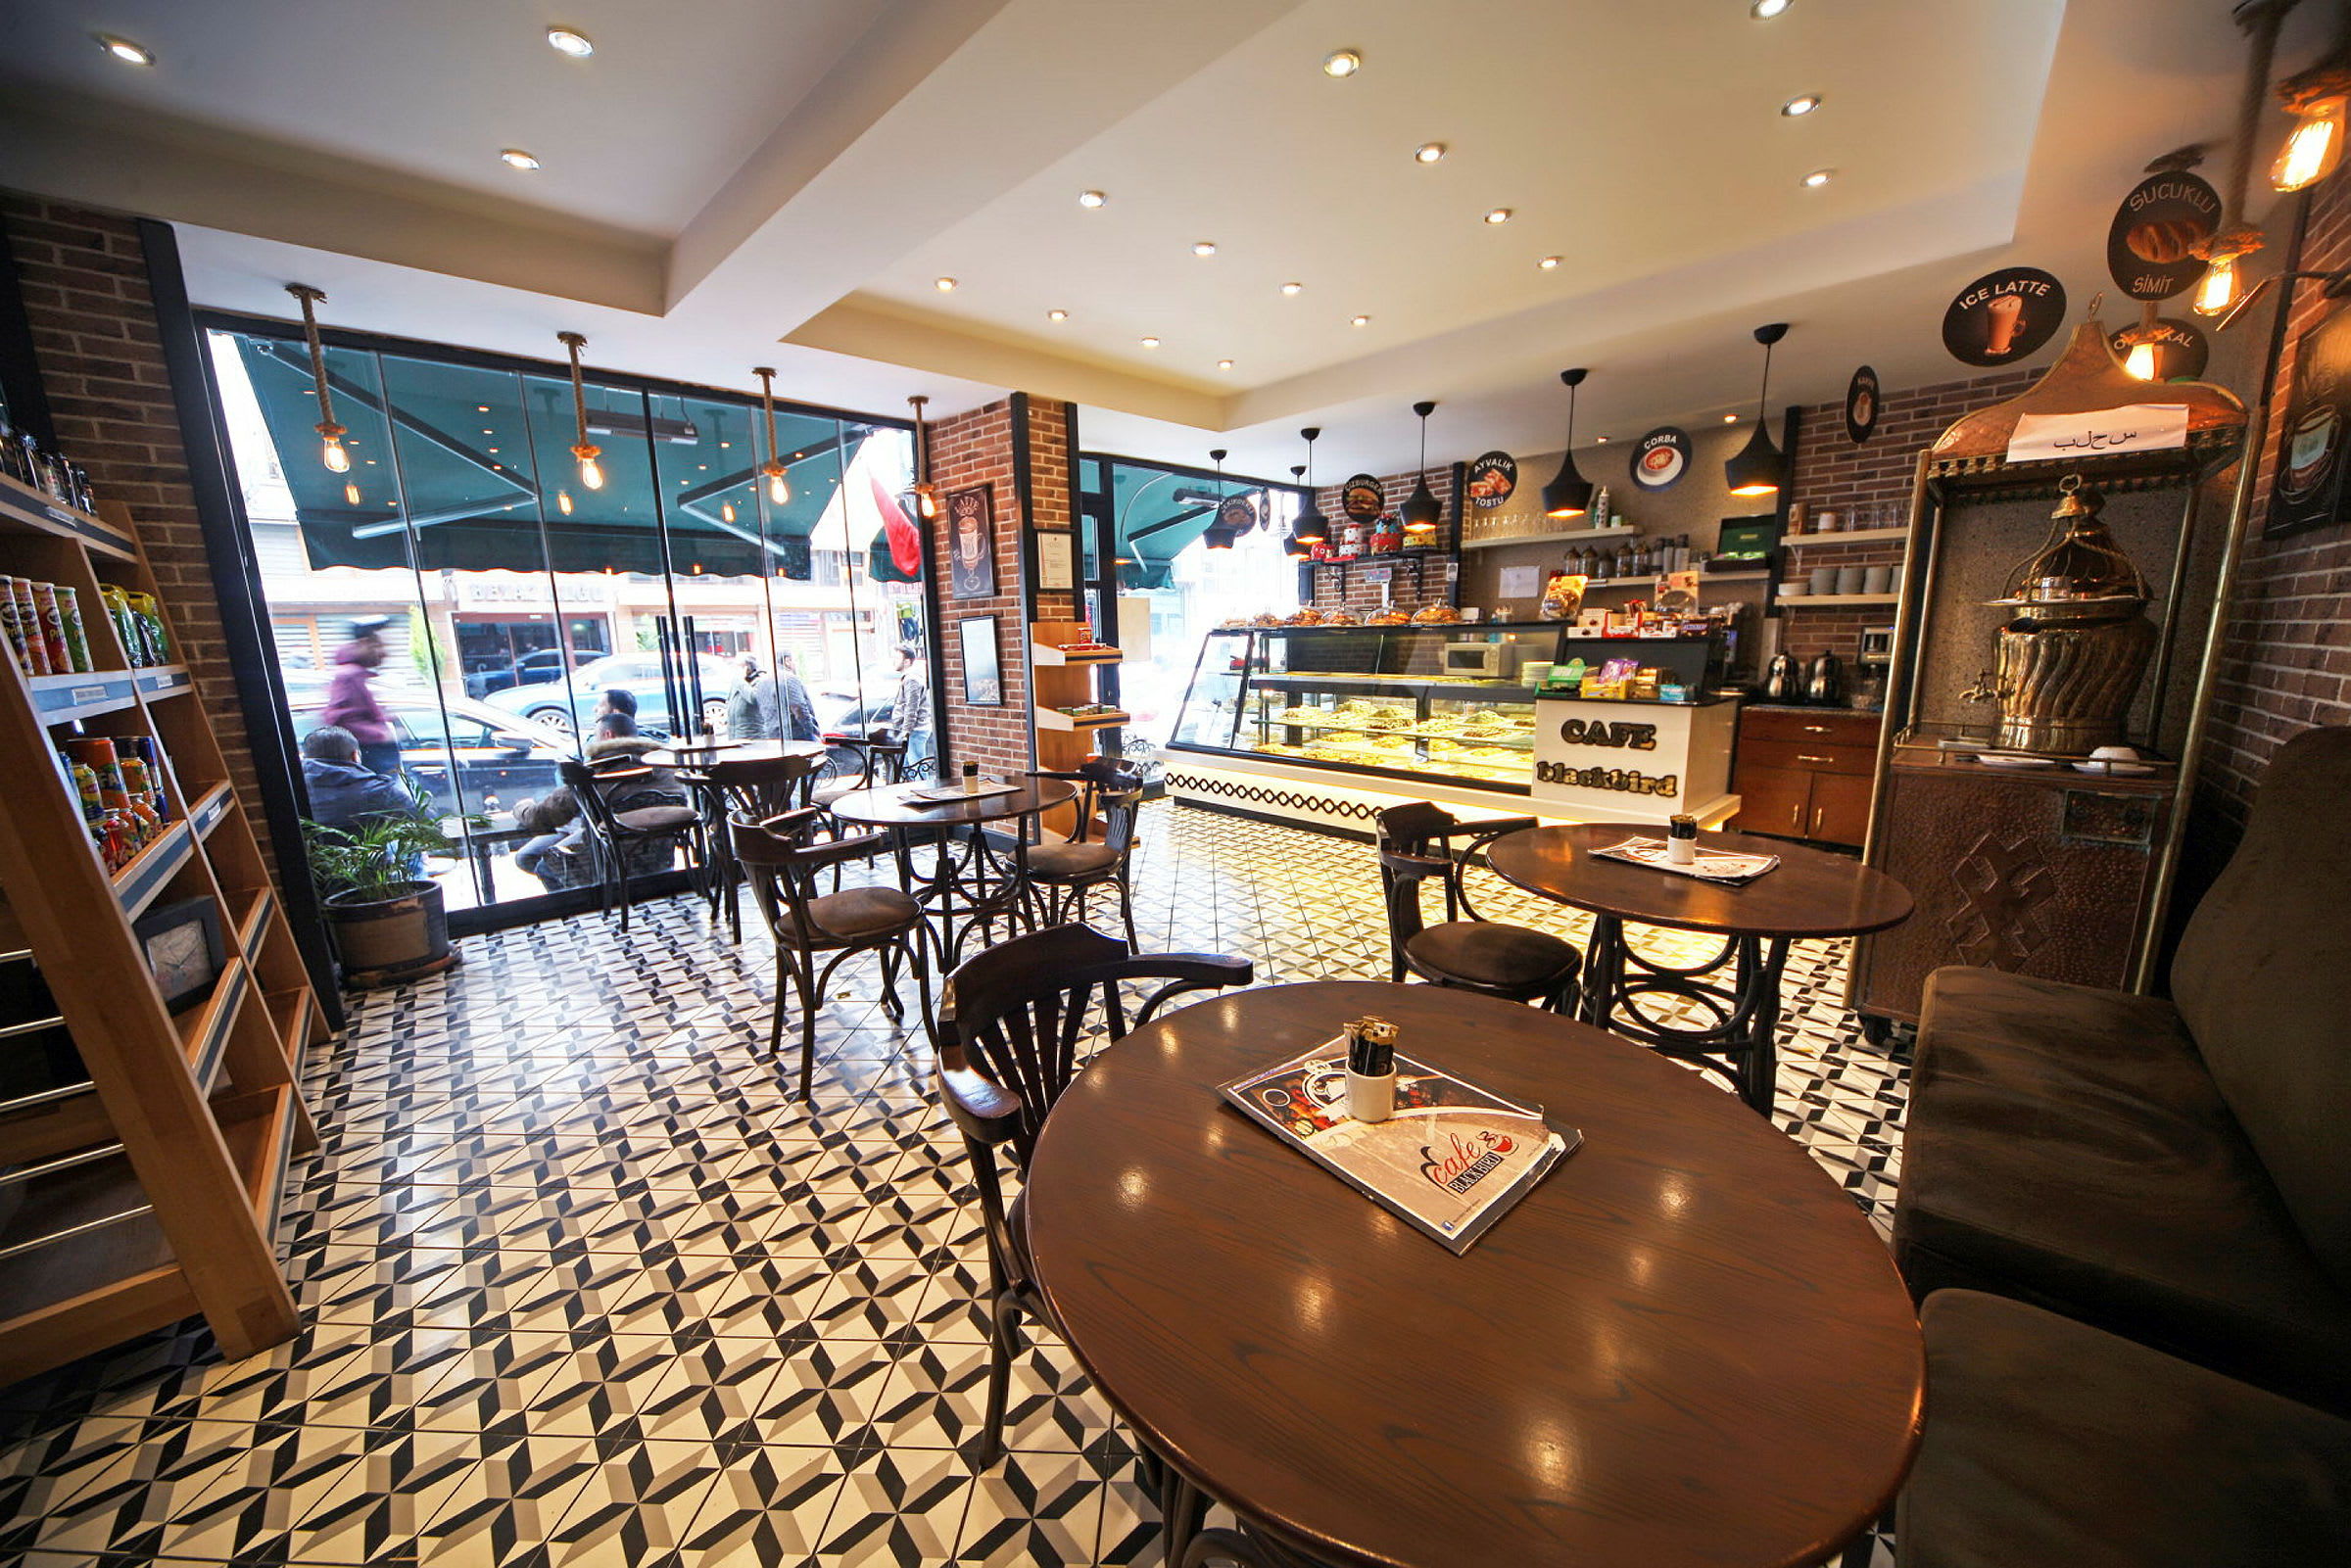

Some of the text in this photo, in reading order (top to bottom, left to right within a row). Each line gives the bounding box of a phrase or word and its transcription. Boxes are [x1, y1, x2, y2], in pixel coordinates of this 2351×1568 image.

[2130, 182, 2216, 214] SUCUKLU
[1959, 280, 2051, 309] ICE LATTE
[1474, 457, 1513, 474] AYVALIK
[1475, 497, 1505, 507] TOSTU
[1560, 719, 1656, 750] CAFE
[1536, 761, 1678, 797] blackbird
